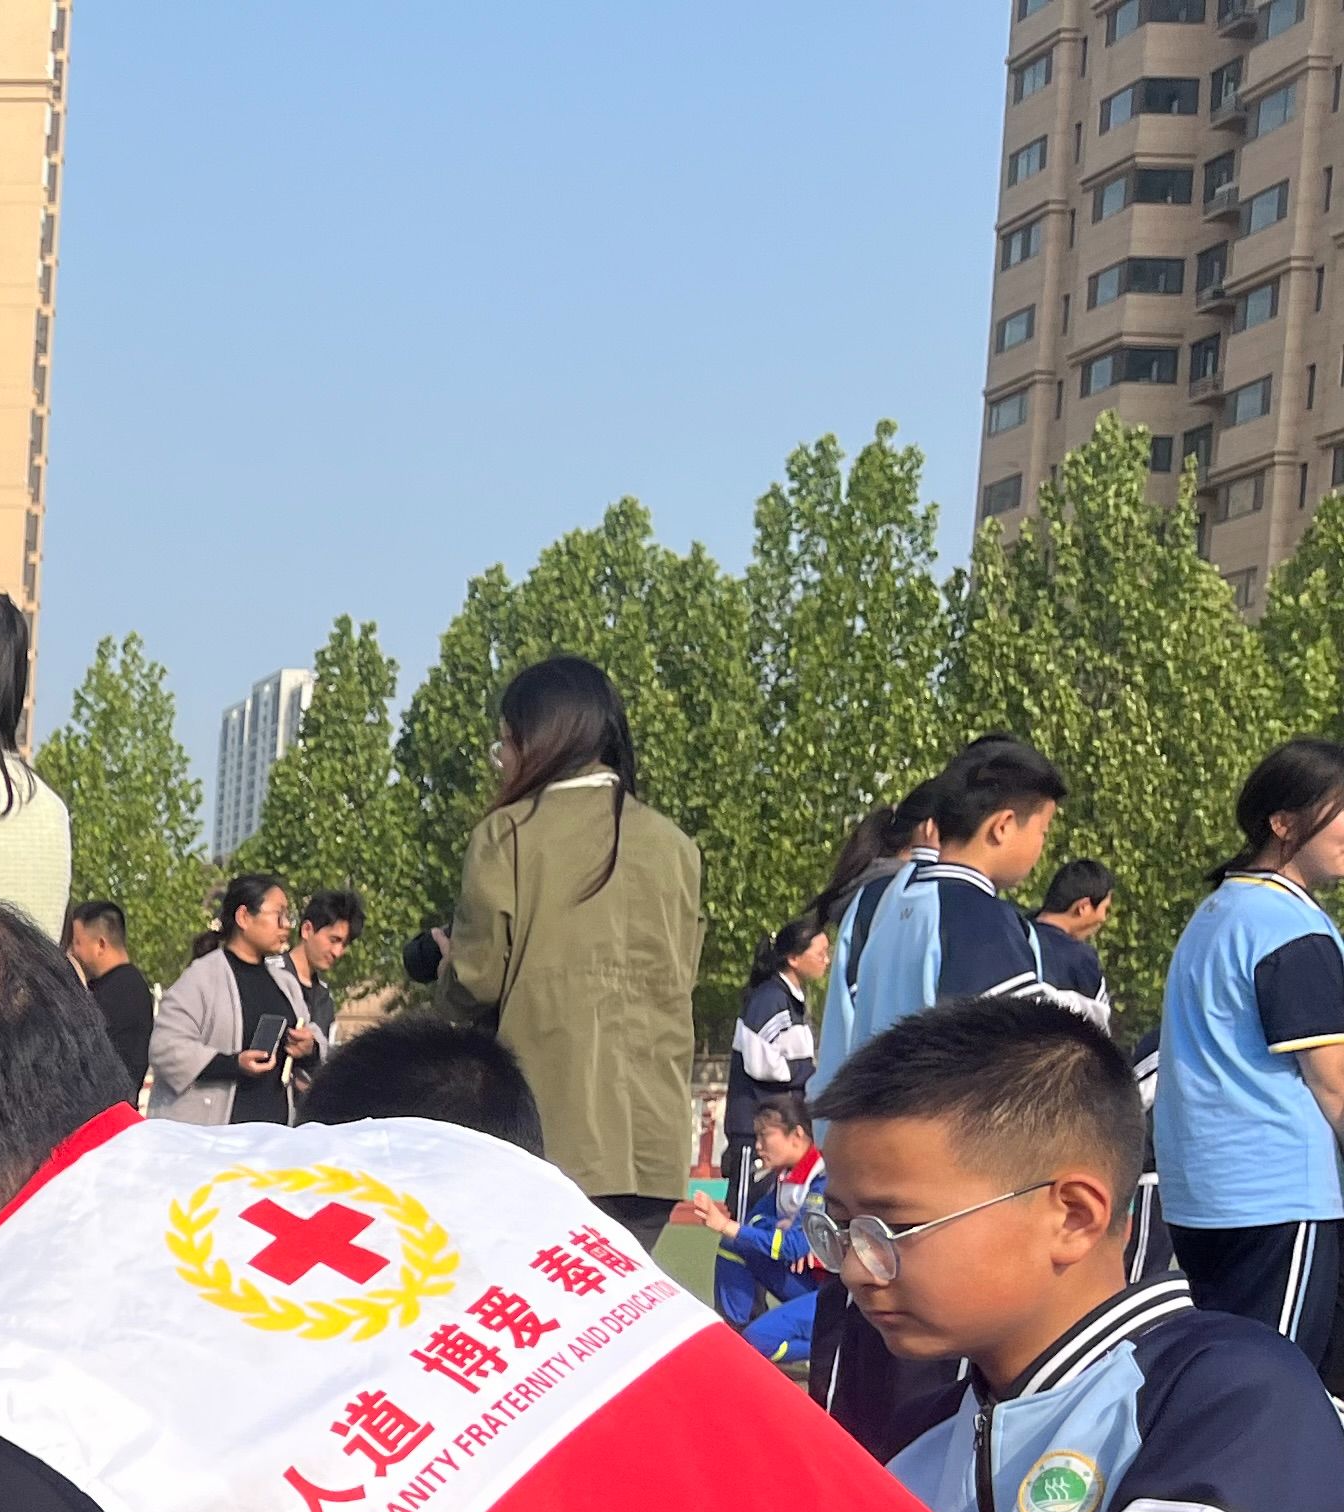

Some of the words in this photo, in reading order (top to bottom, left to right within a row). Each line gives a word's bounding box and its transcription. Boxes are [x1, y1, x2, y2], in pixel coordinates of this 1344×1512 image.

[409, 1285, 561, 1394] 博爱
[529, 1224, 645, 1297] 奉献
[452, 1351, 576, 1457] FRATERNITY
[567, 1325, 611, 1363] AND
[599, 1279, 681, 1335] DEDICATION
